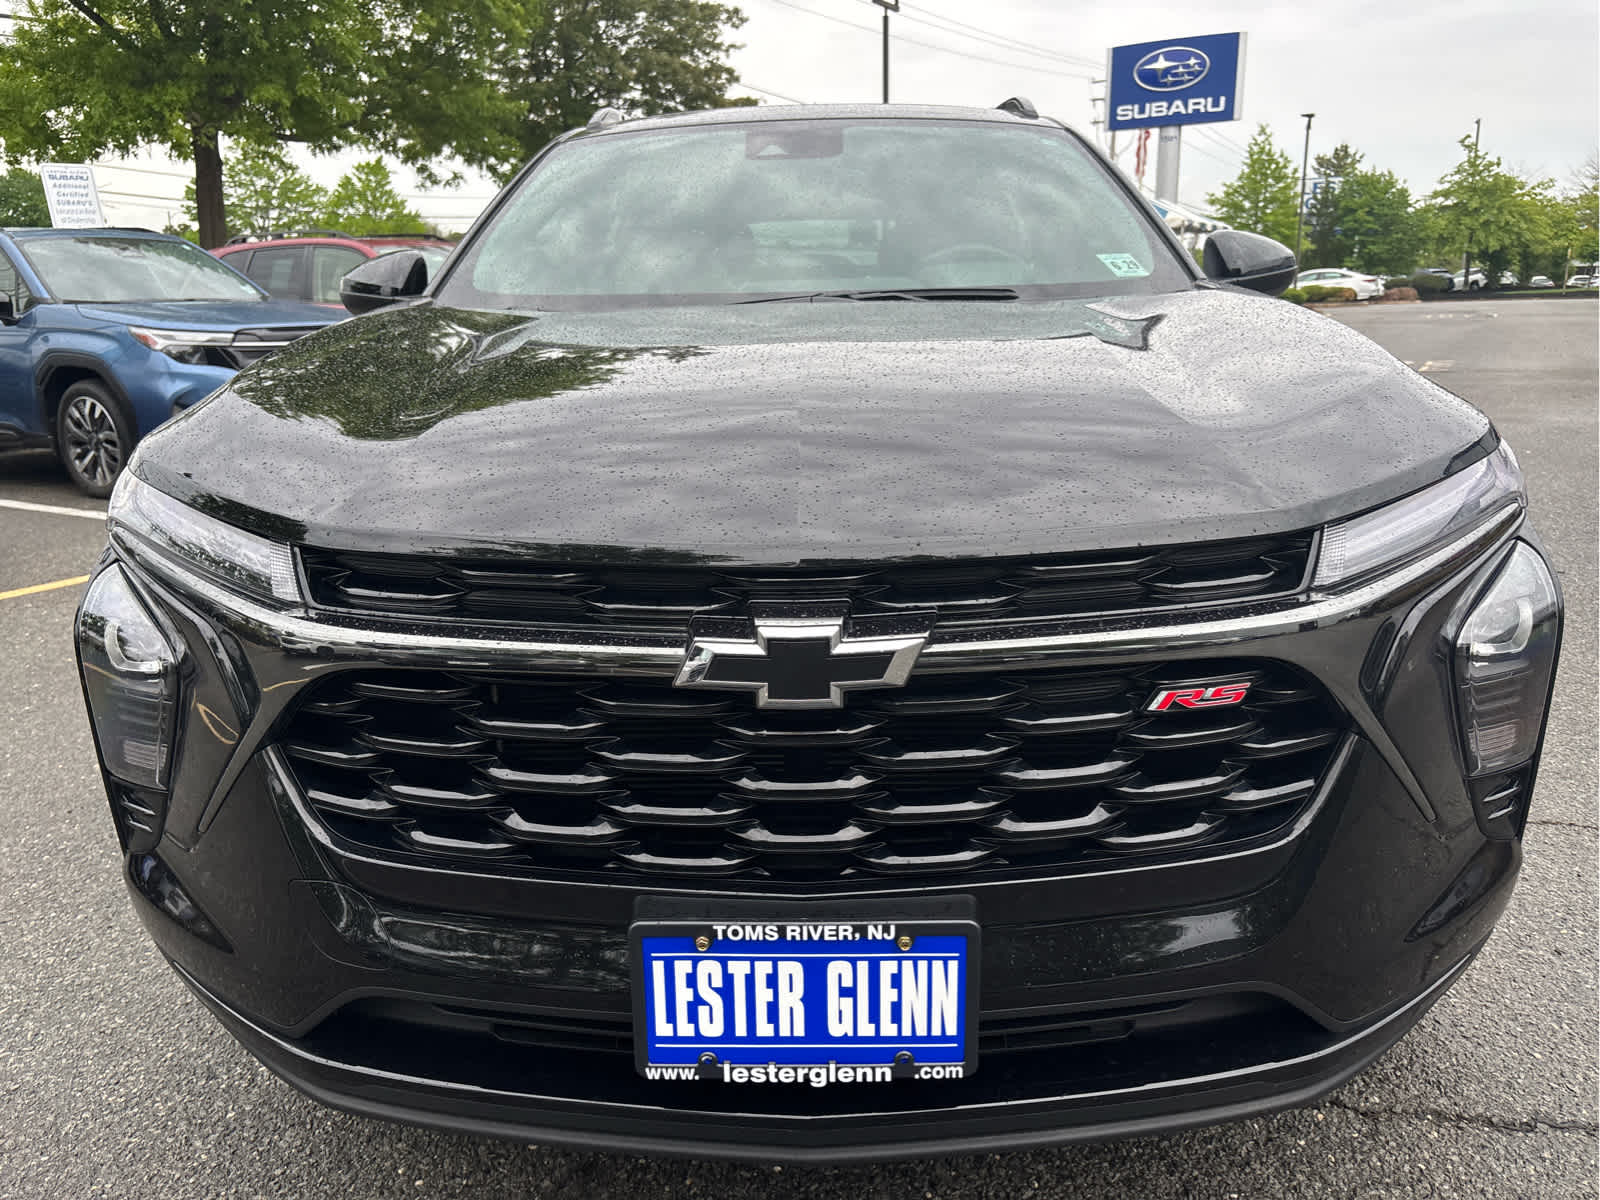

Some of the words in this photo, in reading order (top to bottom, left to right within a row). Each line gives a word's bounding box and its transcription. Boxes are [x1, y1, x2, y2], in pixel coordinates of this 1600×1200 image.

[1115, 95, 1226, 121] SUBARU
[1147, 682, 1251, 711] RS
[712, 925, 779, 941] TOMS
[786, 925, 860, 941] RIVER,
[868, 924, 896, 940] NJ
[652, 960, 806, 1037] LESTER
[826, 960, 959, 1037] GLENN
[645, 1067, 700, 1080] www.
[723, 1063, 892, 1087] lesterglenn
[913, 1065, 964, 1080] .com
